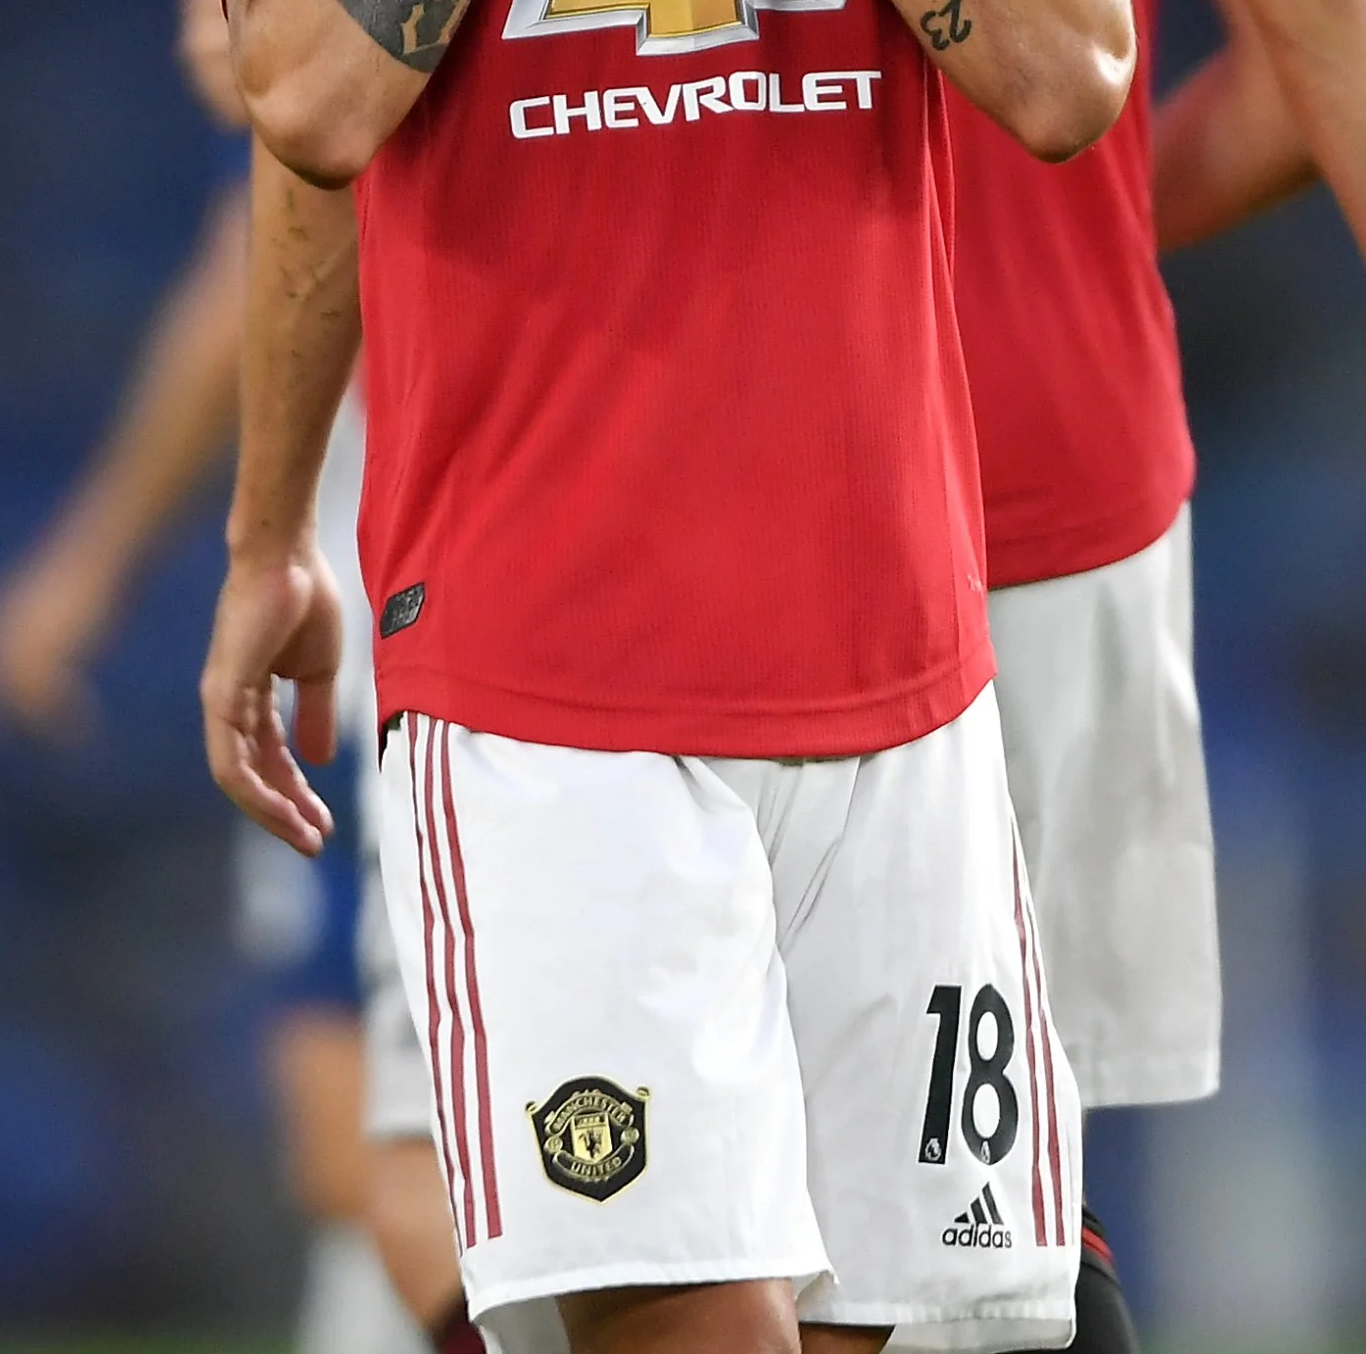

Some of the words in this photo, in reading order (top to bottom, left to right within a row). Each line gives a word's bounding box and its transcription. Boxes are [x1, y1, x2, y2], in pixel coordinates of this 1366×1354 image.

[508, 71, 882, 139] CHEVROLET
[918, 983, 1019, 1166] 18
[554, 1096, 627, 1130] MANCHESTER
[571, 1156, 622, 1175] UNITED
[941, 1222, 1013, 1249] adidas
